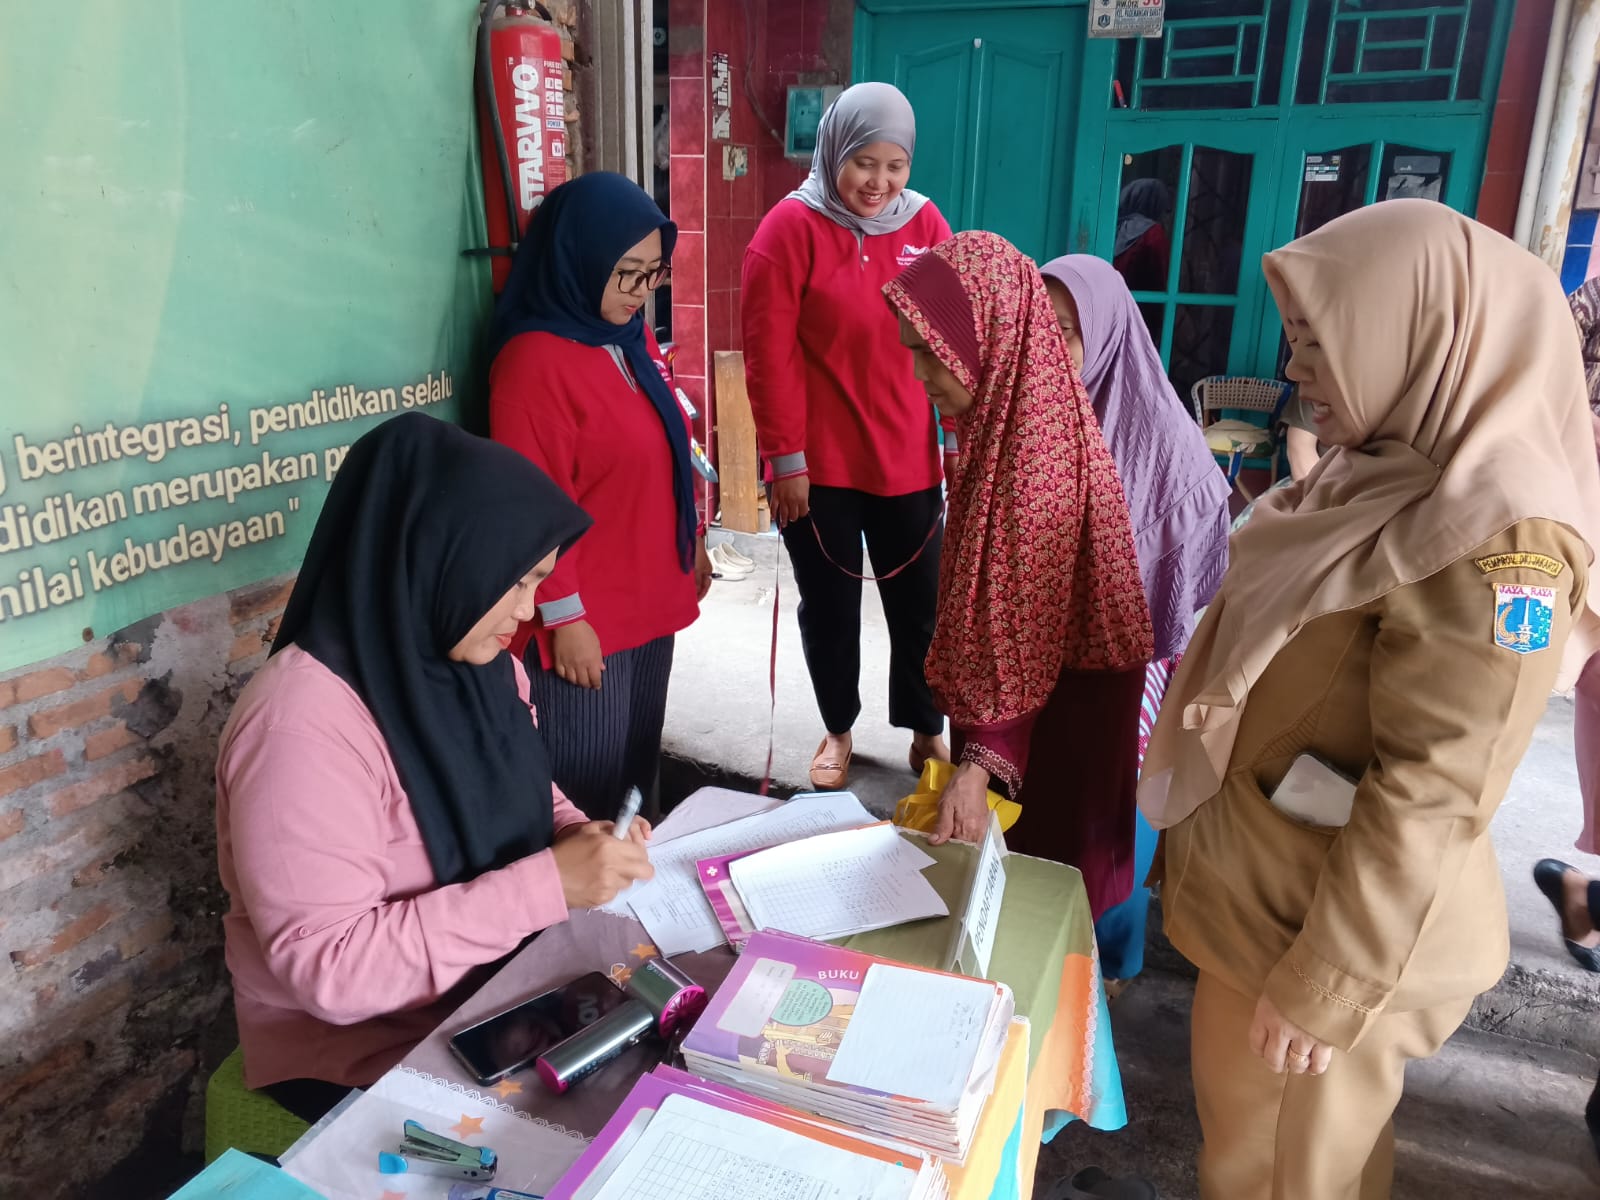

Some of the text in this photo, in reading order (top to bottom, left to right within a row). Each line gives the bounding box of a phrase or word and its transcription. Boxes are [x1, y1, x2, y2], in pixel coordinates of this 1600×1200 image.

[15, 403, 241, 480] berintegrasi,
[250, 384, 397, 444] pendidikan
[401, 370, 453, 407] selalu
[133, 451, 318, 515] merupakan
[88, 509, 285, 592] kebudayaan
[1499, 584, 1553, 598] JAYA RAYA
[974, 855, 1000, 952] PENDAFTARAN
[817, 968, 860, 981] BUKU
